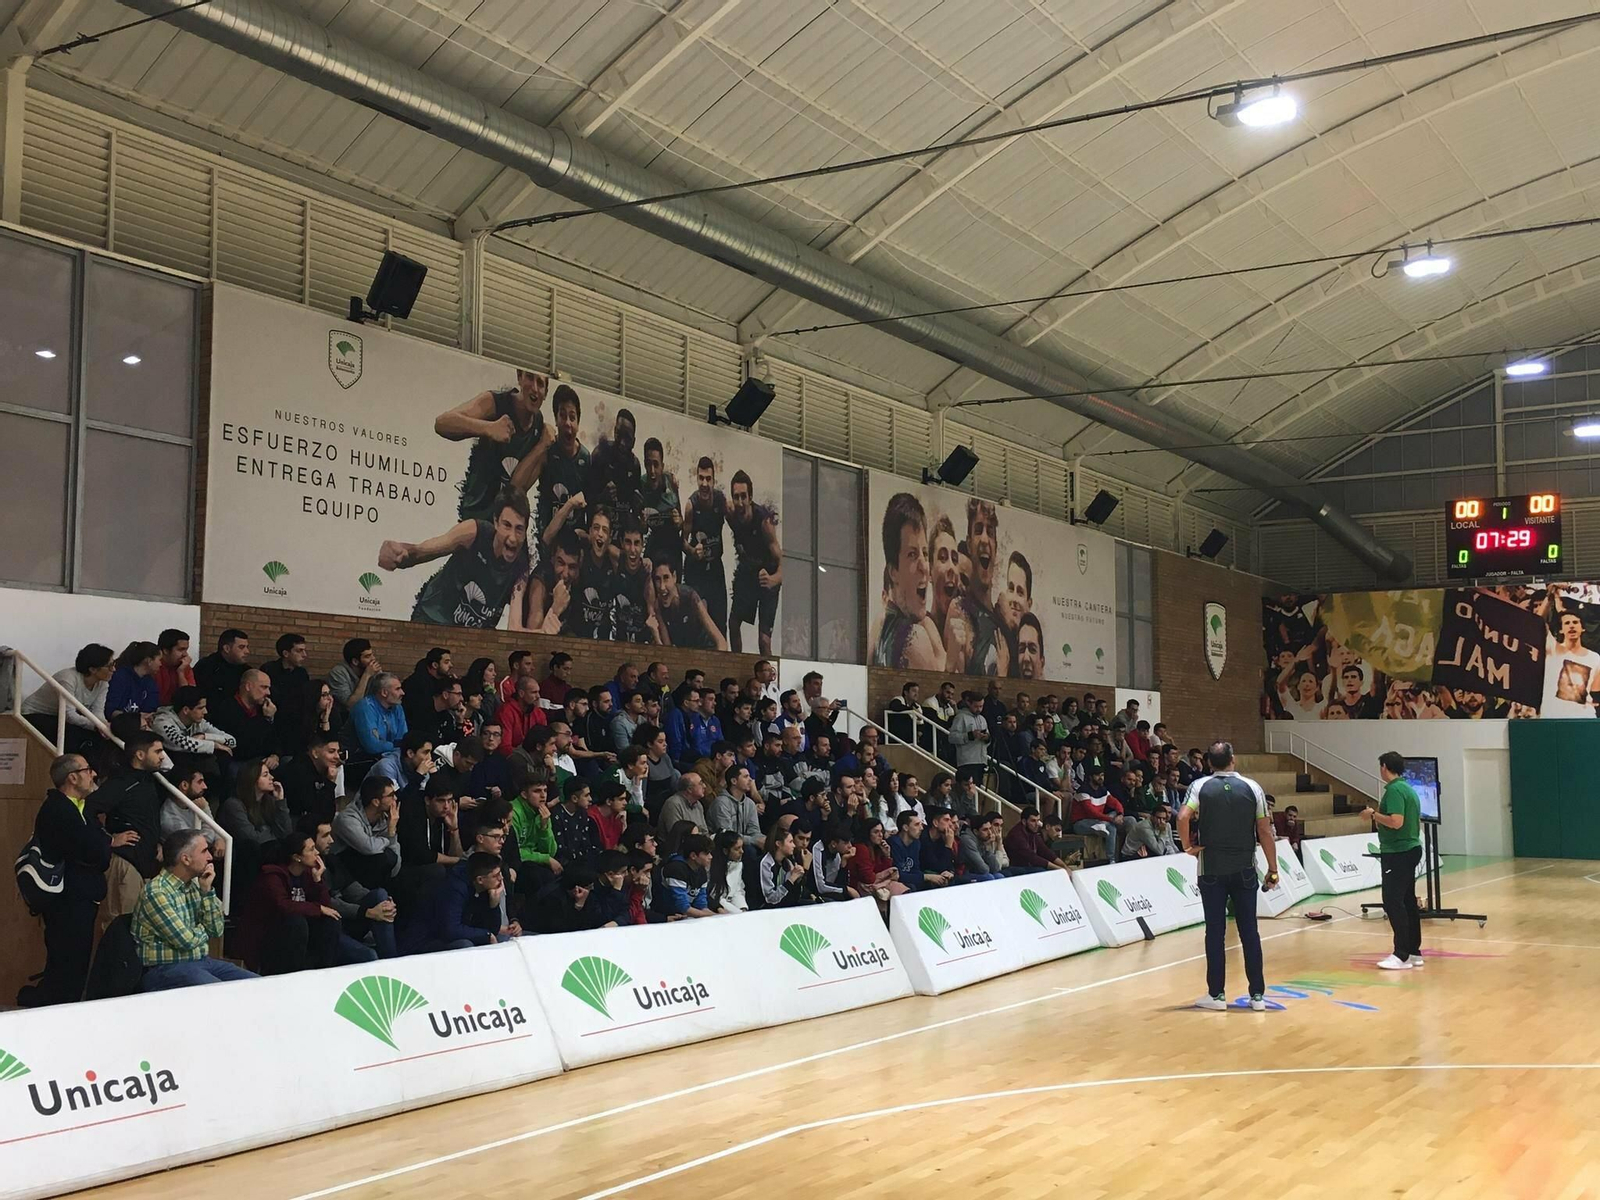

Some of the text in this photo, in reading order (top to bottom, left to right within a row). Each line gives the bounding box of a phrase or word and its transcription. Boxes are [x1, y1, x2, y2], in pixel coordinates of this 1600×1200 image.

[275, 409, 408, 447] NUESTROS VALORES
[222, 423, 448, 483] ESFUERZO HUMILDAD
[237, 455, 435, 507] ENTREGA TRABAJO
[302, 496, 379, 523] EQUIPO
[1455, 500, 1479, 518] 00
[1502, 507, 1507, 520] 1
[1530, 494, 1554, 514] 00
[1450, 521, 1480, 530] LOCAL
[1524, 515, 1555, 525] VISITANTE
[1476, 530, 1531, 549] 07:29
[1458, 550, 1468, 563] 0
[1548, 544, 1558, 558] 0
[263, 586, 288, 596] Unicaja
[359, 596, 380, 606] Unicaja
[1052, 596, 1112, 614] NUESTRA CANTERA
[1124, 894, 1152, 913] Unicaja
[1050, 905, 1082, 926] Unicaja
[954, 926, 992, 950] Unicaja
[832, 942, 890, 972] Unicaja
[632, 976, 710, 1012] Unicaja
[428, 998, 528, 1038] Unicaja
[27, 1059, 180, 1118] Unicaja
